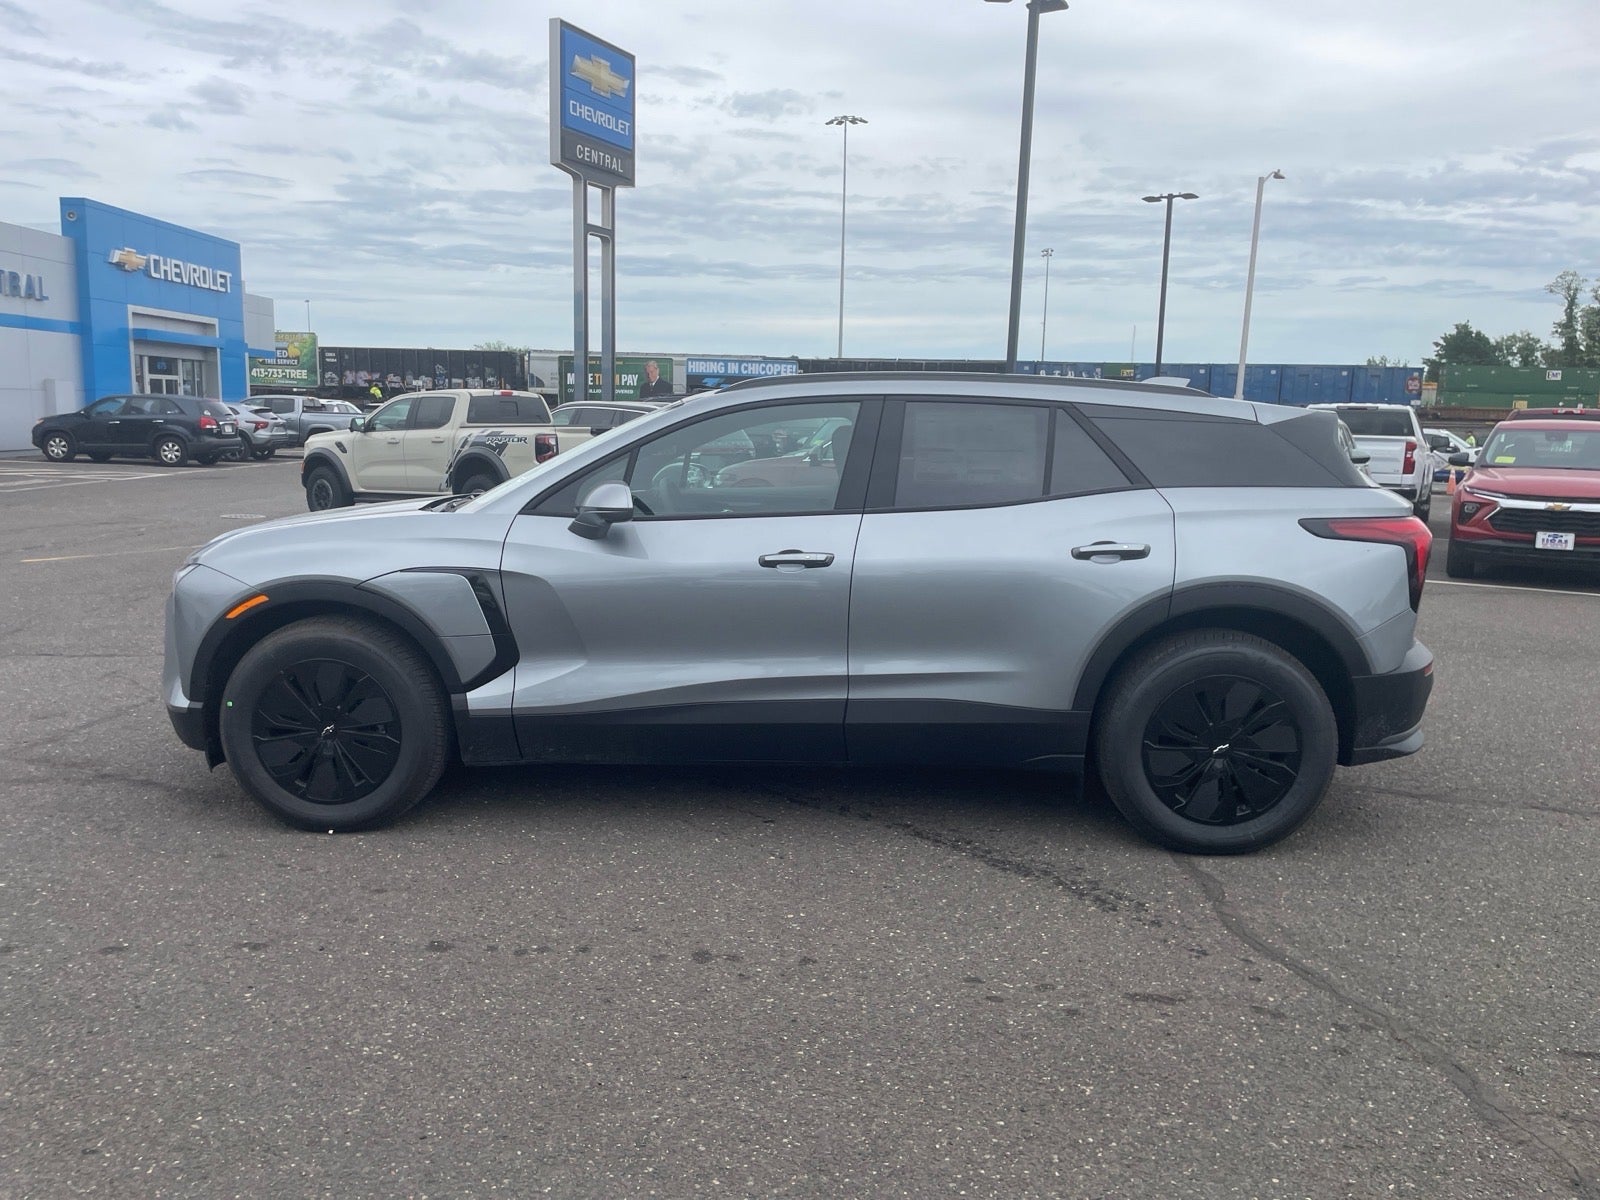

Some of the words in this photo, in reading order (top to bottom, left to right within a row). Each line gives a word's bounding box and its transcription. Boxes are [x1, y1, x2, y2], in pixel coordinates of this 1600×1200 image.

[569, 100, 630, 136] CHEVROLET
[576, 144, 624, 173] CENTRAL
[149, 254, 232, 293] CHEVROLET
[251, 368, 308, 379] 413-733-TREE
[688, 361, 724, 373] HIRING
[727, 362, 739, 374] IN
[741, 363, 796, 375] CHICOPEE!
[567, 372, 593, 385] ME
[621, 374, 638, 386] PAY
[486, 436, 528, 446] RAPTOR
